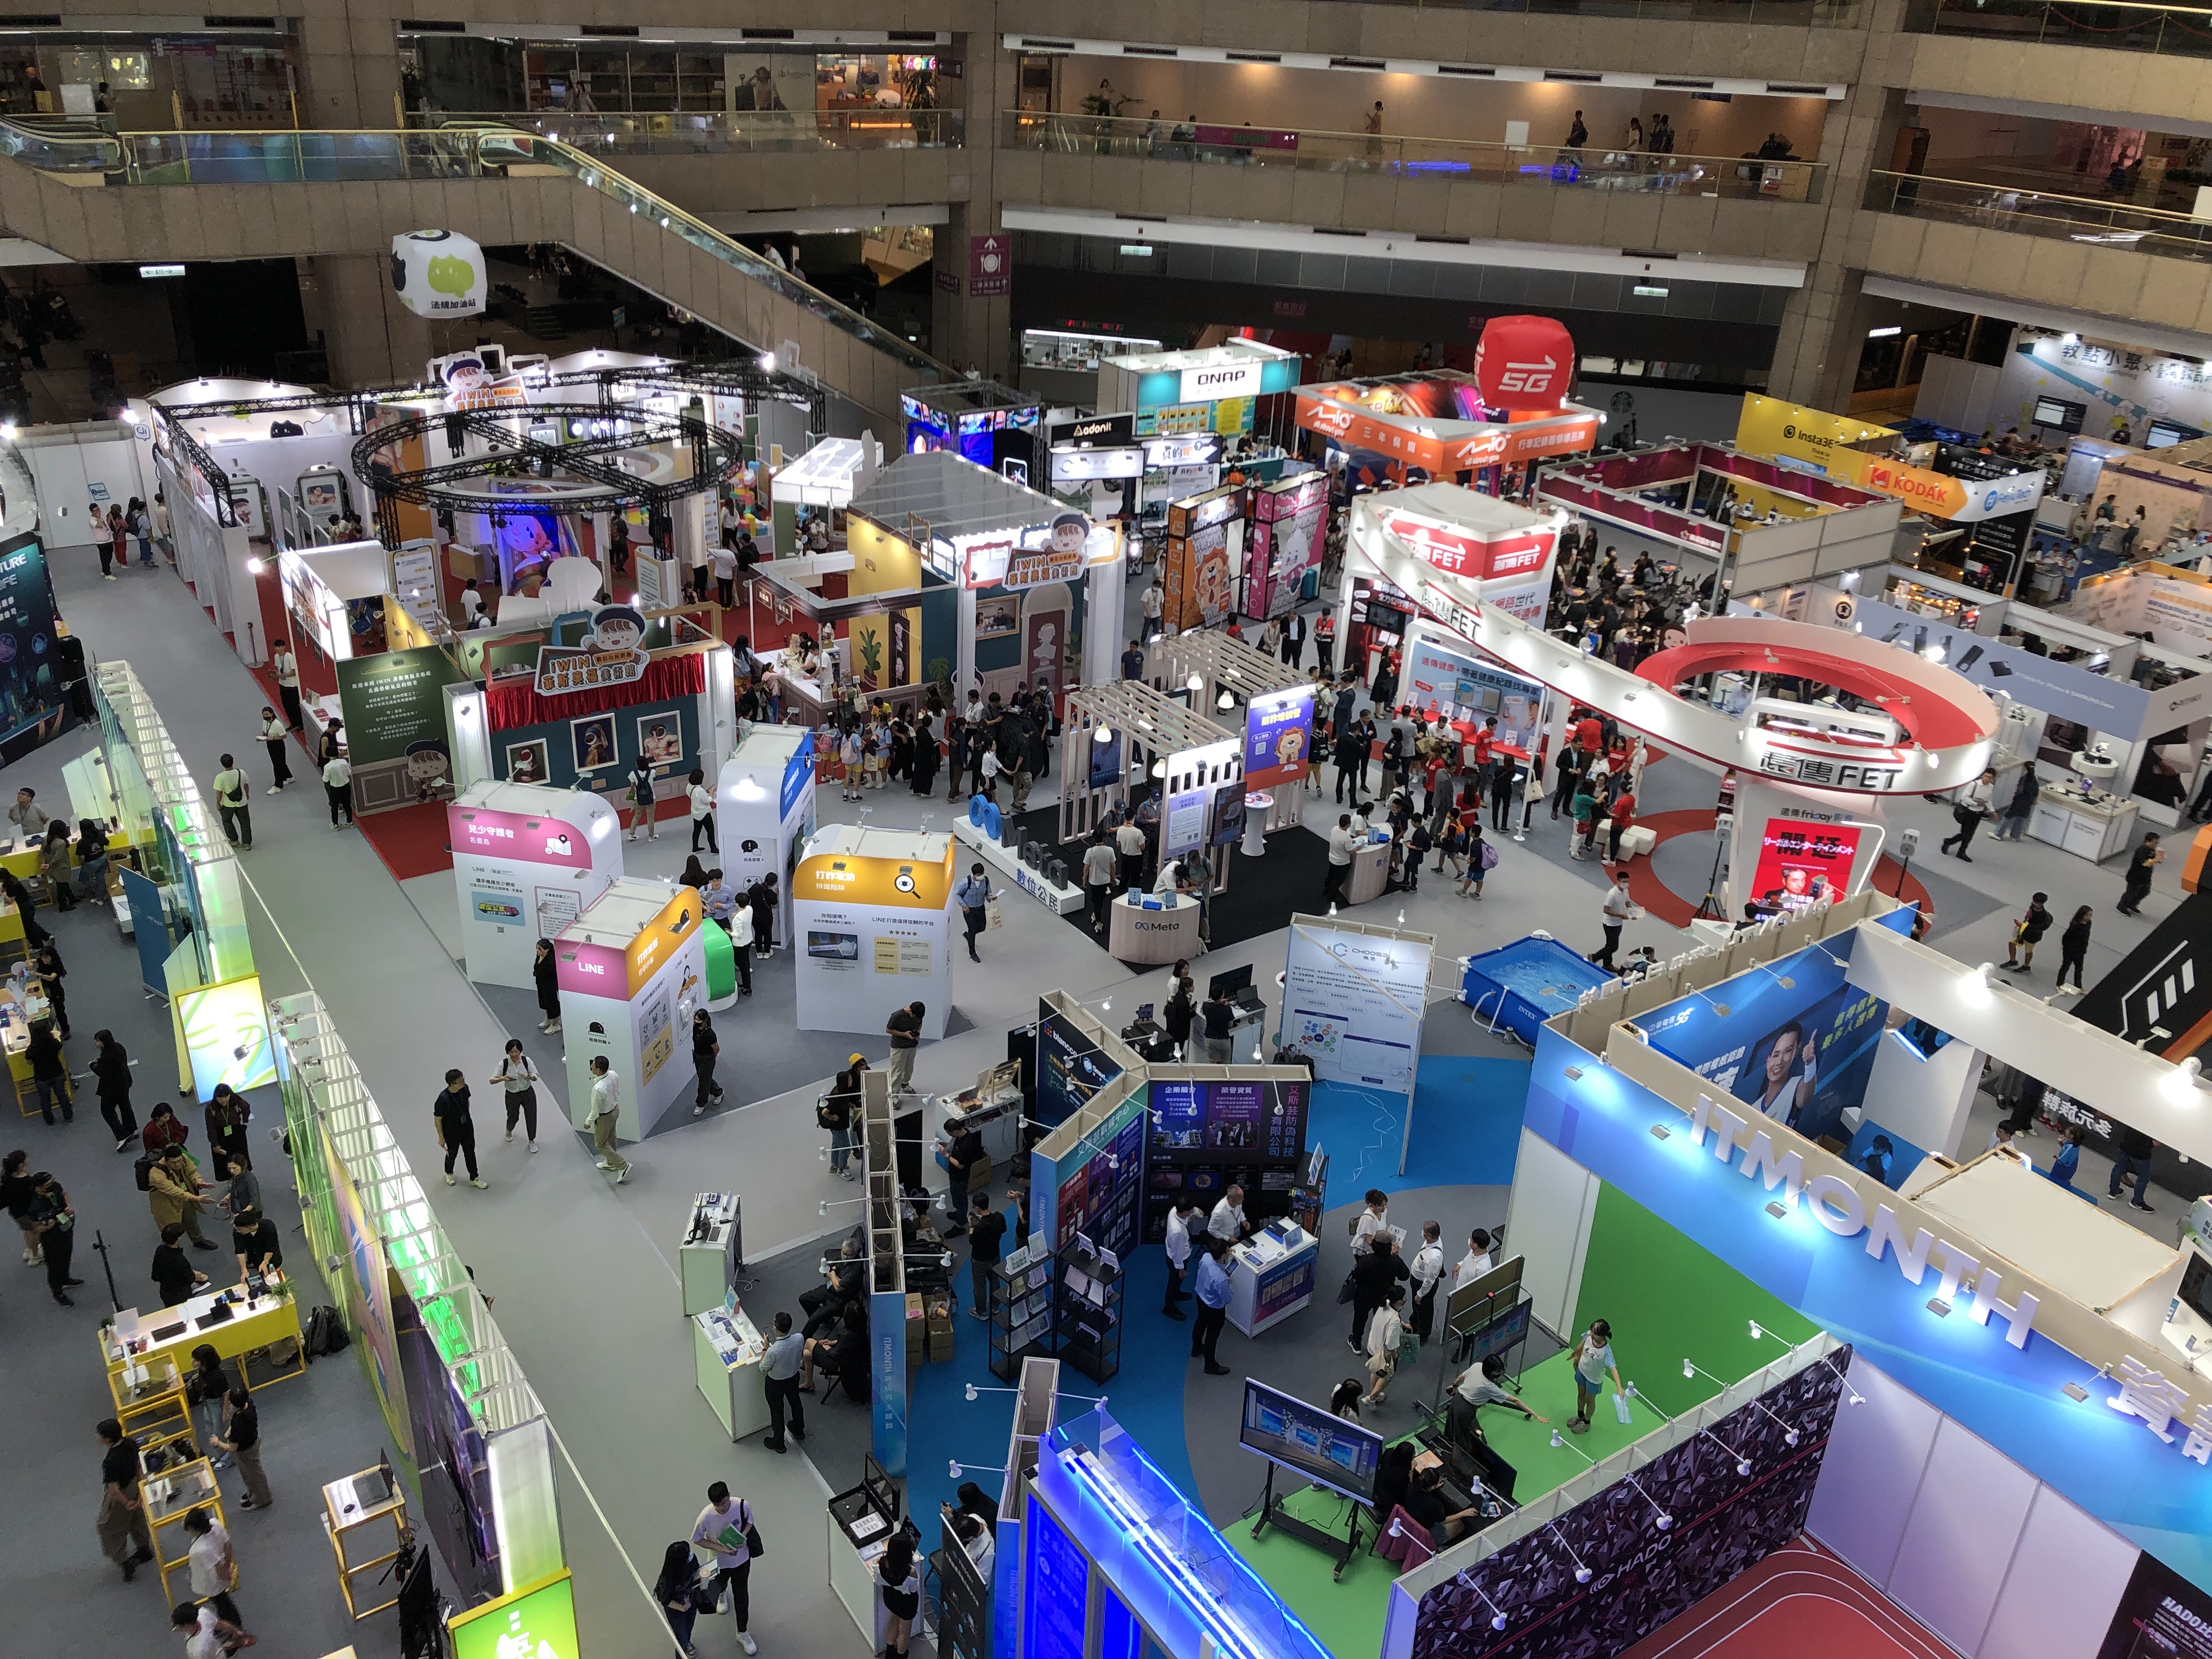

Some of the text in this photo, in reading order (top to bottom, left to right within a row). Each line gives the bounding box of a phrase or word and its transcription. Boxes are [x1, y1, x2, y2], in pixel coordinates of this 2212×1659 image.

[431, 298, 476, 309] 法規加油站
[1198, 370, 1245, 385] QNAP
[1499, 373, 1552, 392] 5G
[1083, 421, 1112, 435] adonit
[1893, 476, 1947, 504] KODAK
[1431, 549, 1466, 570] FET
[1517, 550, 1541, 567] FET
[1451, 607, 1482, 641] FET
[542, 663, 637, 691] 菲斯奧福美術館
[1837, 764, 1904, 789] FET
[469, 824, 514, 839] 兒少守護者
[470, 837, 490, 845] 名畫島
[1001, 815, 1069, 890] Meta
[1015, 868, 1059, 913] 數位公民
[1151, 921, 1180, 932] Meta
[578, 962, 605, 975] LINE
[1518, 1005, 1537, 1022] INTEX
[1053, 1030, 1077, 1058] blancco
[1283, 1085, 1300, 1157] 艾斯芸防偽科技
[1268, 1116, 1283, 1157] 有限公司
[1690, 1093, 2041, 1351] ITMONTH
[883, 1337, 893, 1373] ITMONTH
[1617, 1534, 1673, 1579] HADO
